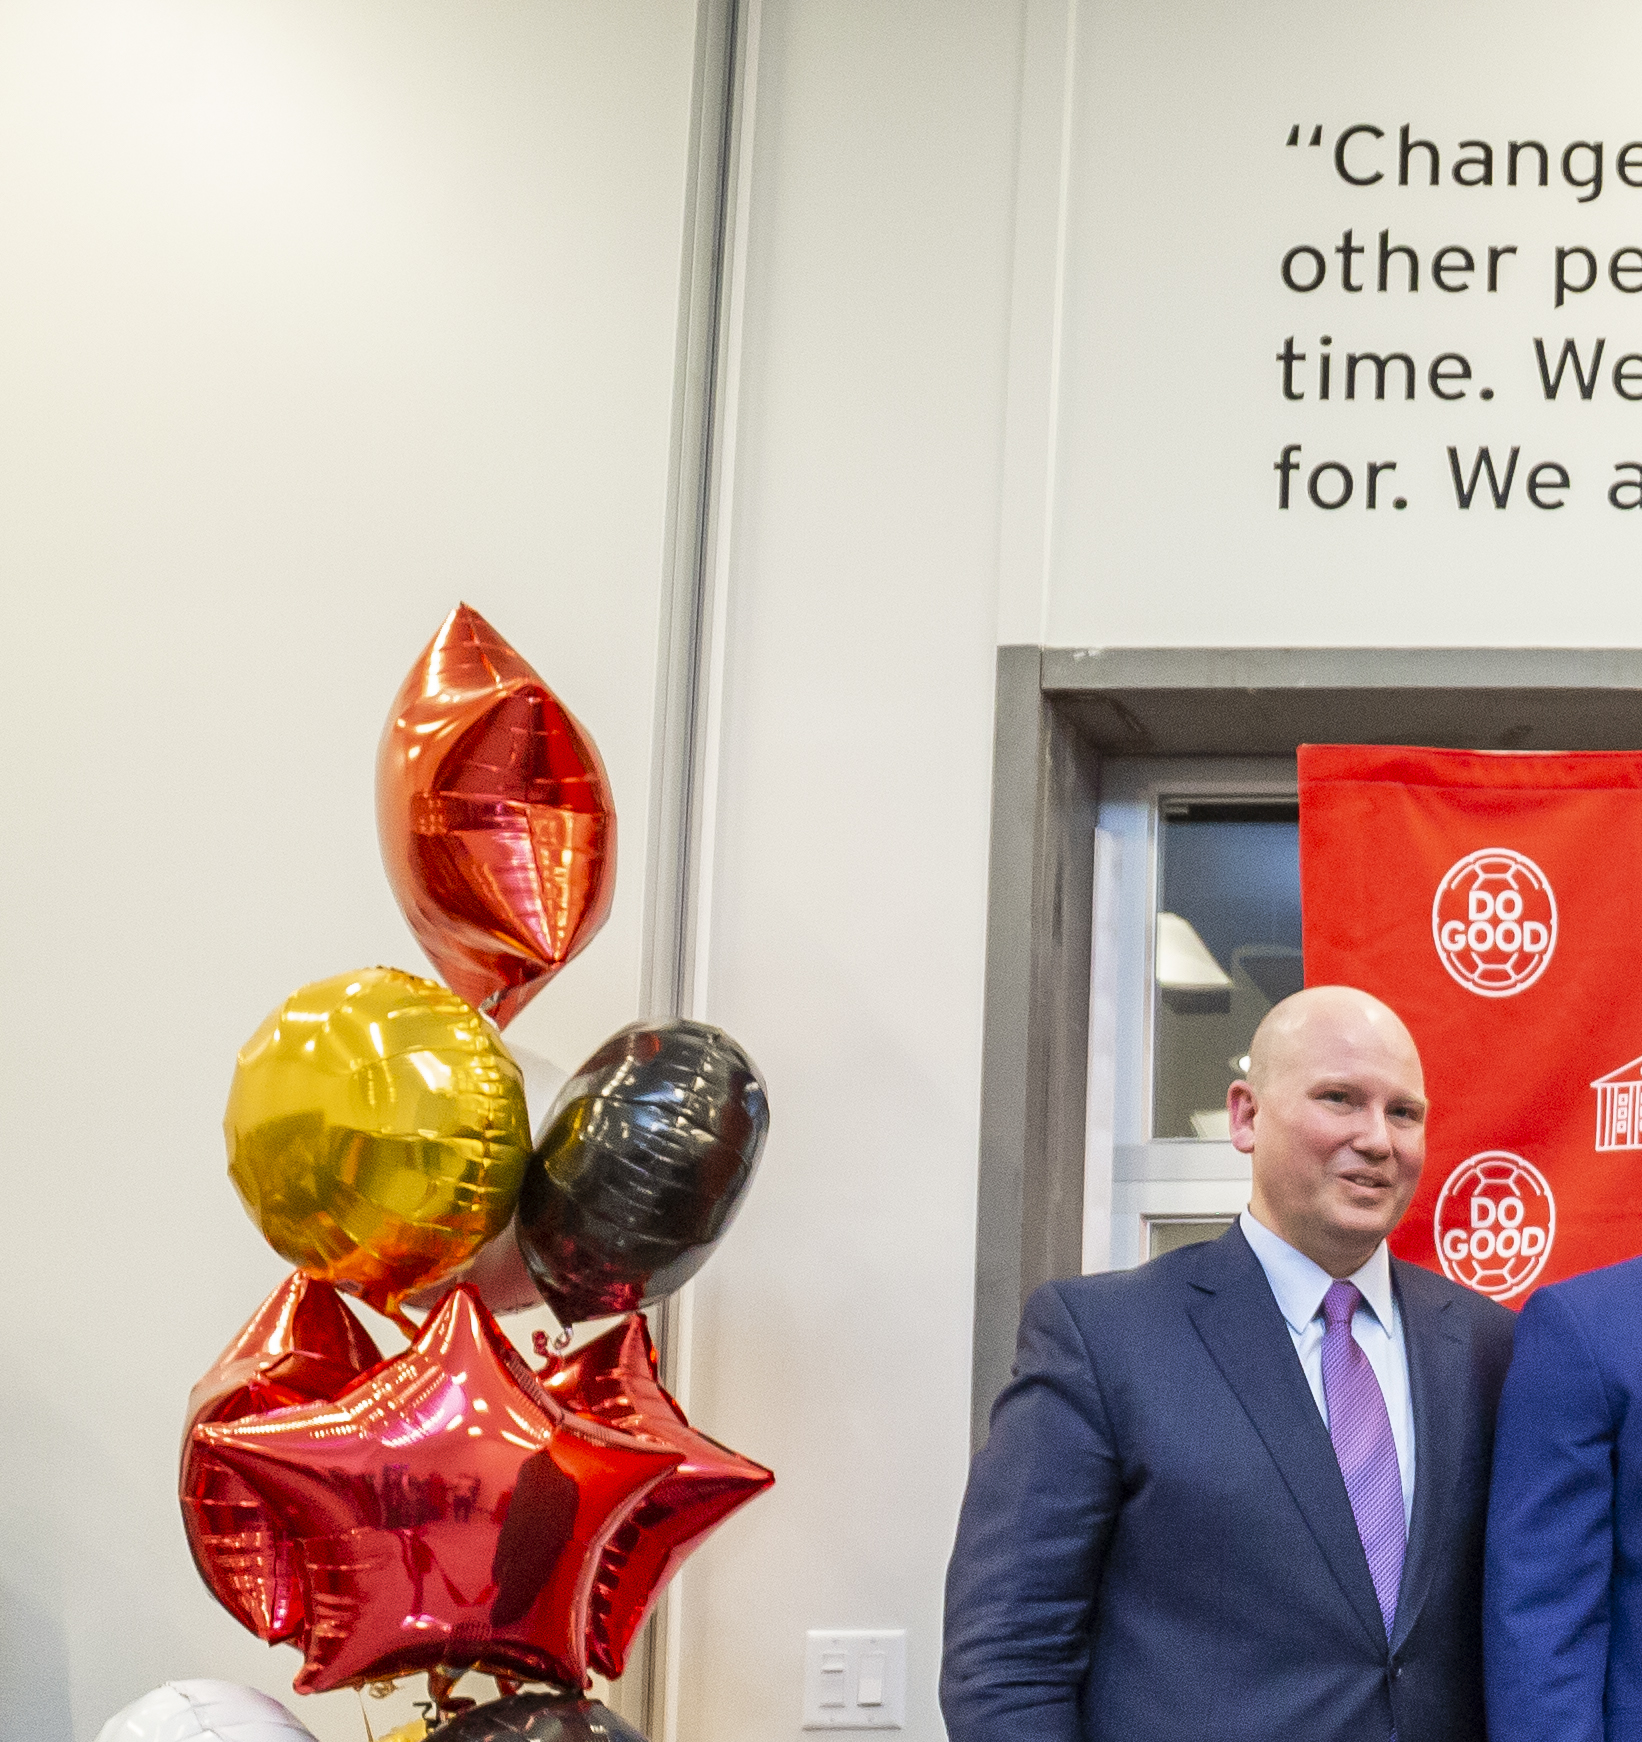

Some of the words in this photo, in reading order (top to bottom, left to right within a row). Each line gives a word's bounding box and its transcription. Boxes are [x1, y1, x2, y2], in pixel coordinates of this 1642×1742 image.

[1281, 228, 1518, 294] other
[1276, 335, 1494, 402] time.
[1273, 444, 1407, 510] for.
[1447, 446, 1570, 510] We
[1468, 890, 1523, 921] DO
[1441, 920, 1548, 952] GOOD
[1470, 1196, 1524, 1229] DO
[1443, 1226, 1545, 1260] GOOD
